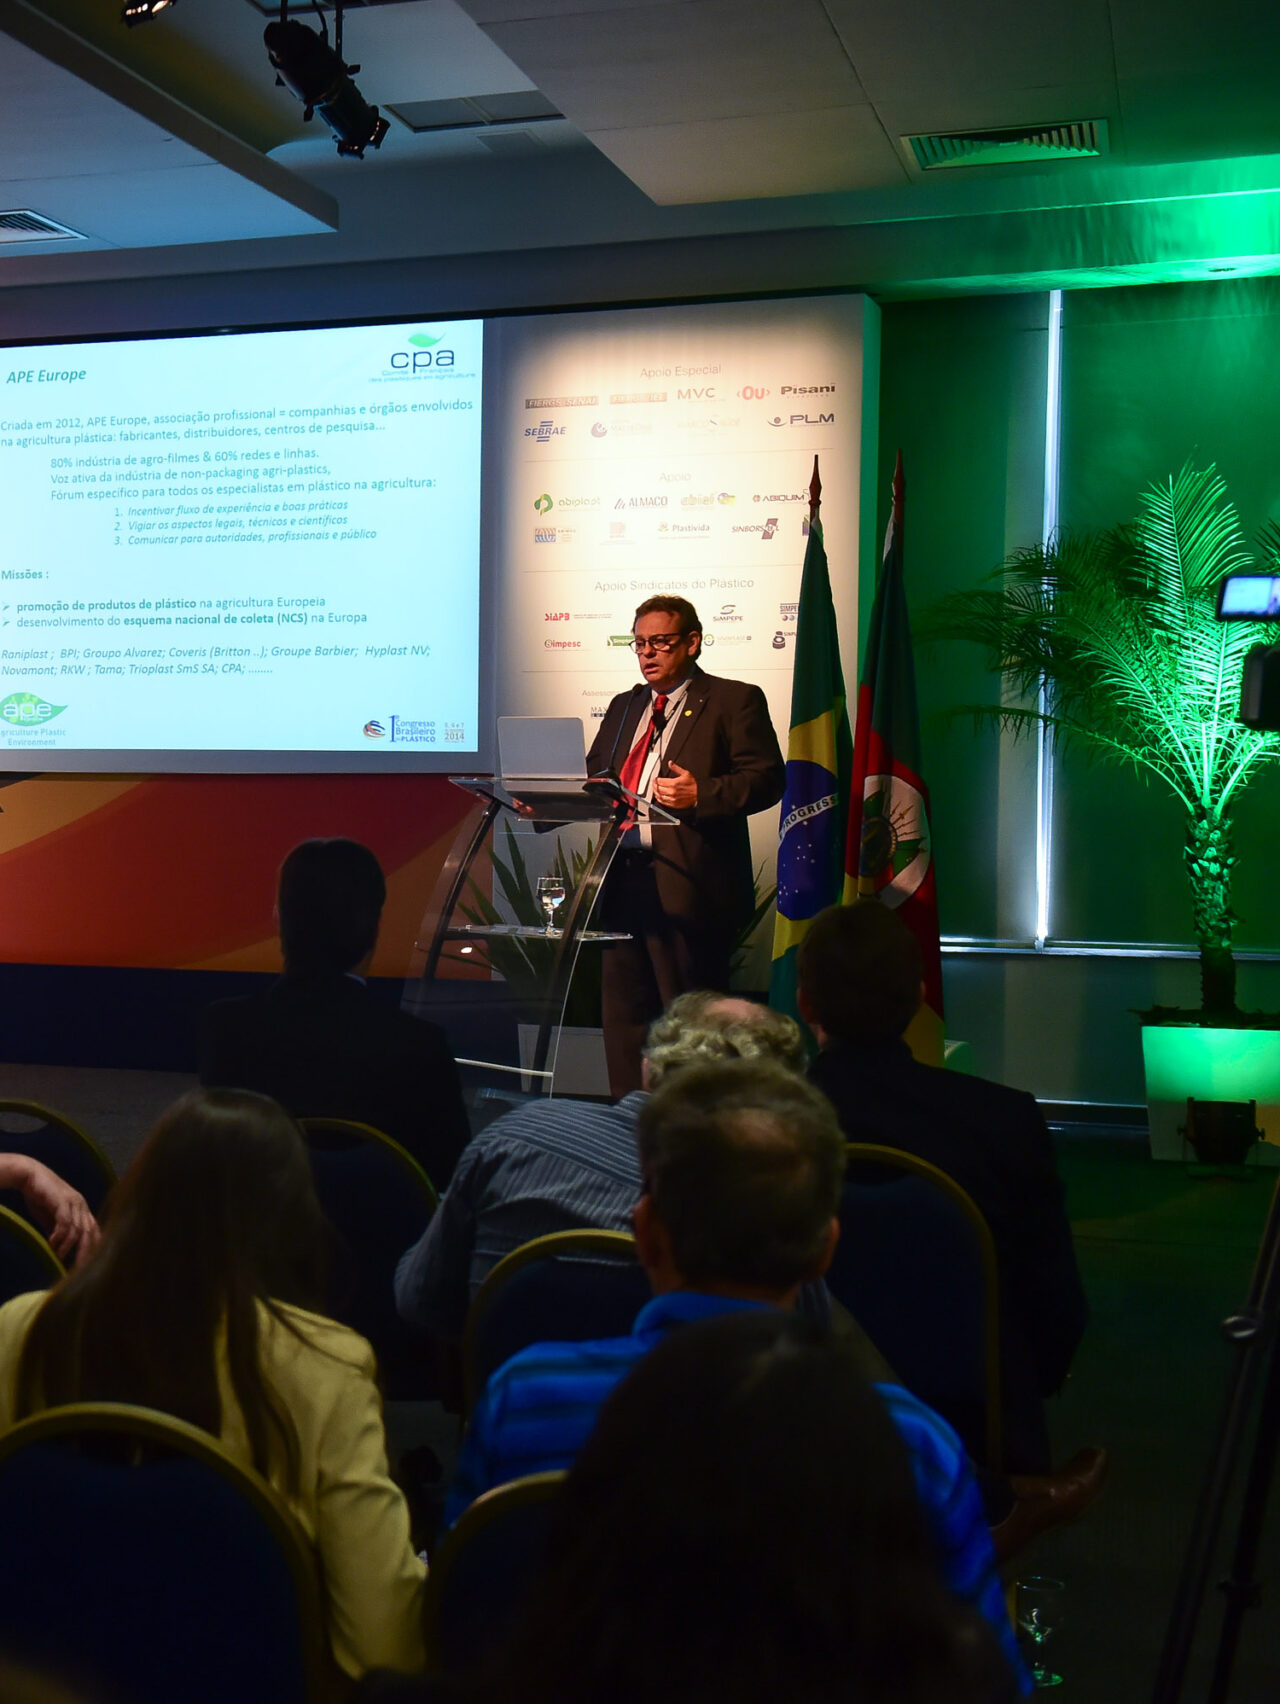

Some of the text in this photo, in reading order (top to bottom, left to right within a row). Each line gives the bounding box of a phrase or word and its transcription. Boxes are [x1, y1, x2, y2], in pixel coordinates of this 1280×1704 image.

[390, 349, 455, 374] cpa
[6, 368, 86, 384] APE Europe
[639, 364, 722, 381] Apoio Especial
[676, 387, 717, 401] MVC
[780, 382, 837, 396] Pisani
[0, 398, 473, 431] Criada em 2012, APE Europe, associação profissional companhias órgãos envolvidos
[789, 412, 836, 425] PLM
[0, 419, 385, 449] na agricultura plástica: fabricantes, distribuidores, centros de pesquisa...
[524, 426, 567, 437] SEBRAE
[50, 456, 73, 468] 80%
[75, 454, 121, 467] indústria
[123, 453, 137, 465] de
[139, 451, 200, 467] agro-filmes
[214, 450, 238, 461] 60%
[240, 448, 271, 460] redes
[283, 446, 319, 459] linhas.
[50, 462, 331, 483] Voz ativa da indústria de non-packaging agri-plastics,
[50, 476, 436, 502] Fórum específico para todos os especialistas em plástico na agricultura:
[672, 521, 711, 533] Plastivida
[1, 567, 43, 579] Missões
[594, 580, 627, 593] Apoio
[629, 578, 688, 592] Sindicatos
[691, 578, 706, 590] do
[16, 595, 325, 614] promoção de produtos de plástico na agricultura Europeia
[16, 610, 367, 628] desenvolvimento do esquema nacional de coleta (NCS) na Europa
[3, 703, 52, 720] ape
[395, 720, 436, 729] Congresso
[395, 727, 436, 735] Brasileiro
